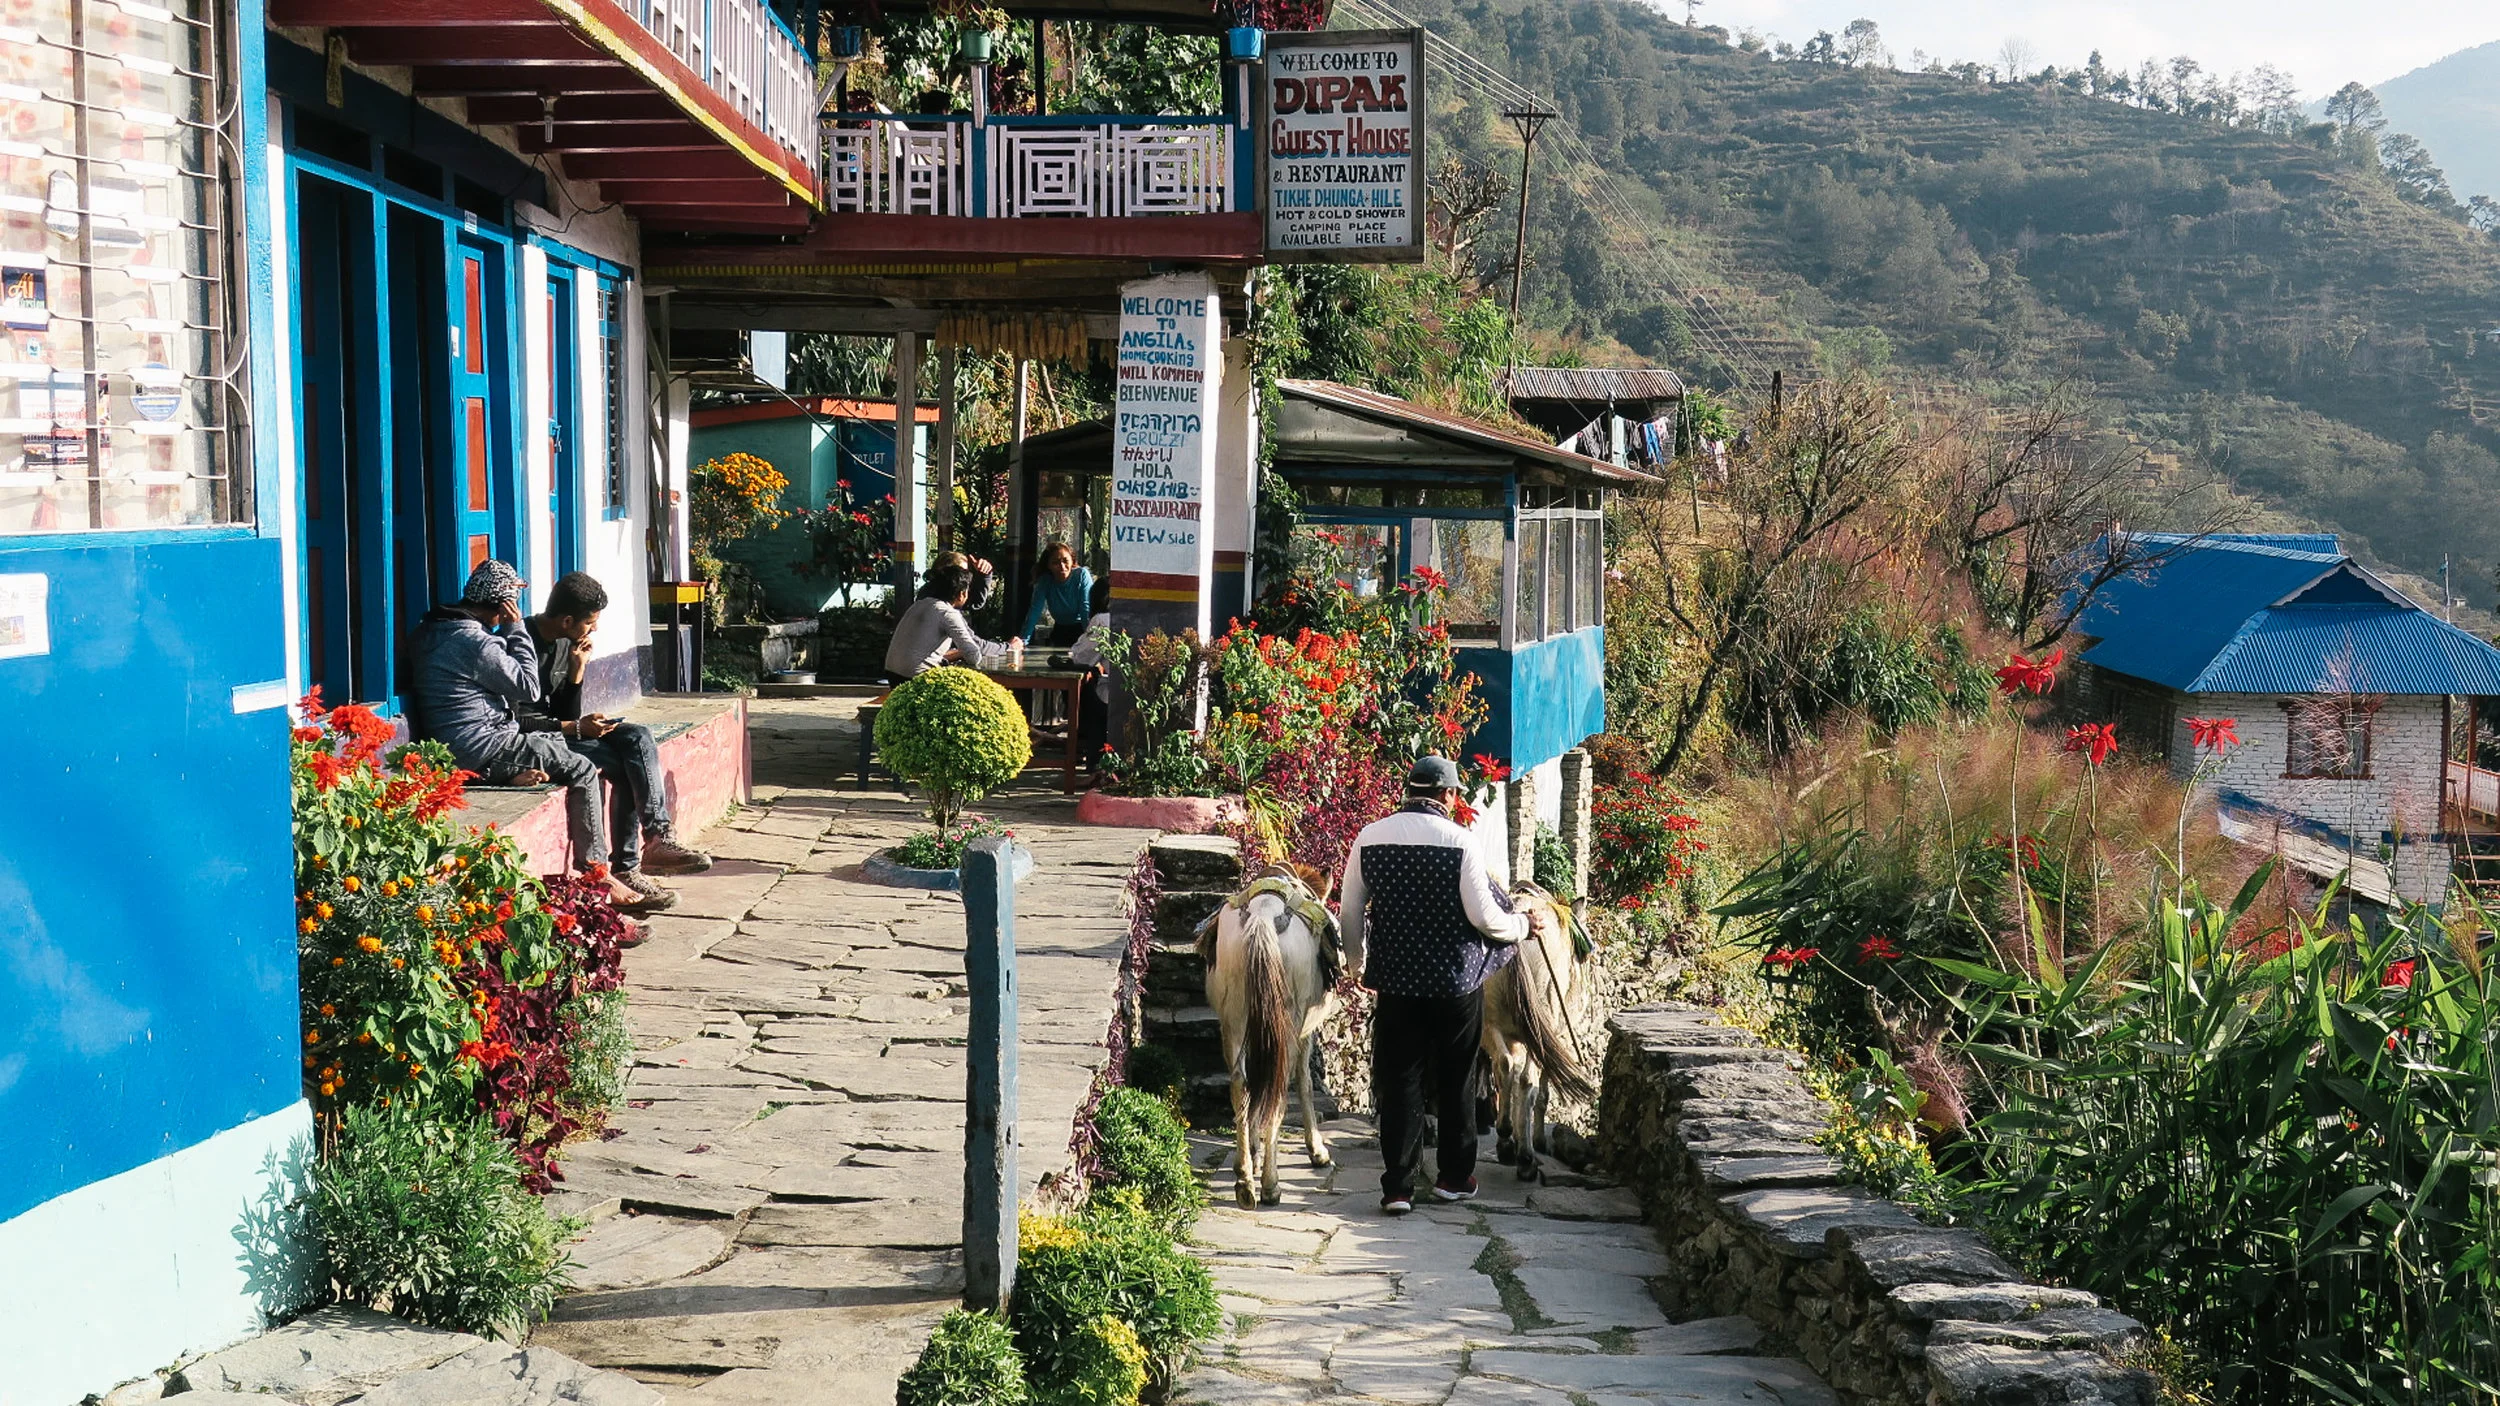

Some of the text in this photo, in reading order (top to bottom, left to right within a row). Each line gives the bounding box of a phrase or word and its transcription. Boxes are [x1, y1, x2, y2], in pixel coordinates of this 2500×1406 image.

[1277, 52, 1399, 71] WELCOME TO
[1273, 75, 1408, 114] DIPAK
[1271, 117, 1411, 159] GUEST HOUSE
[1287, 164, 1406, 183] RESTAURANT
[1275, 189, 1311, 207] TIKHE
[1275, 210, 1305, 220] HOT
[1355, 209, 1406, 219] SHOWER
[1290, 222, 1386, 232] CAMPING PLACE
[1280, 233, 1386, 246] AVAILABLE HERE
[1121, 297, 1205, 317] WELCOME
[1156, 317, 1177, 331] TO
[1119, 365, 1204, 383] WILL KOMMEN
[1120, 384, 1198, 403] BIENVENUE
[1132, 463, 1173, 479] HOLA
[1115, 525, 1195, 545] VIEW side
